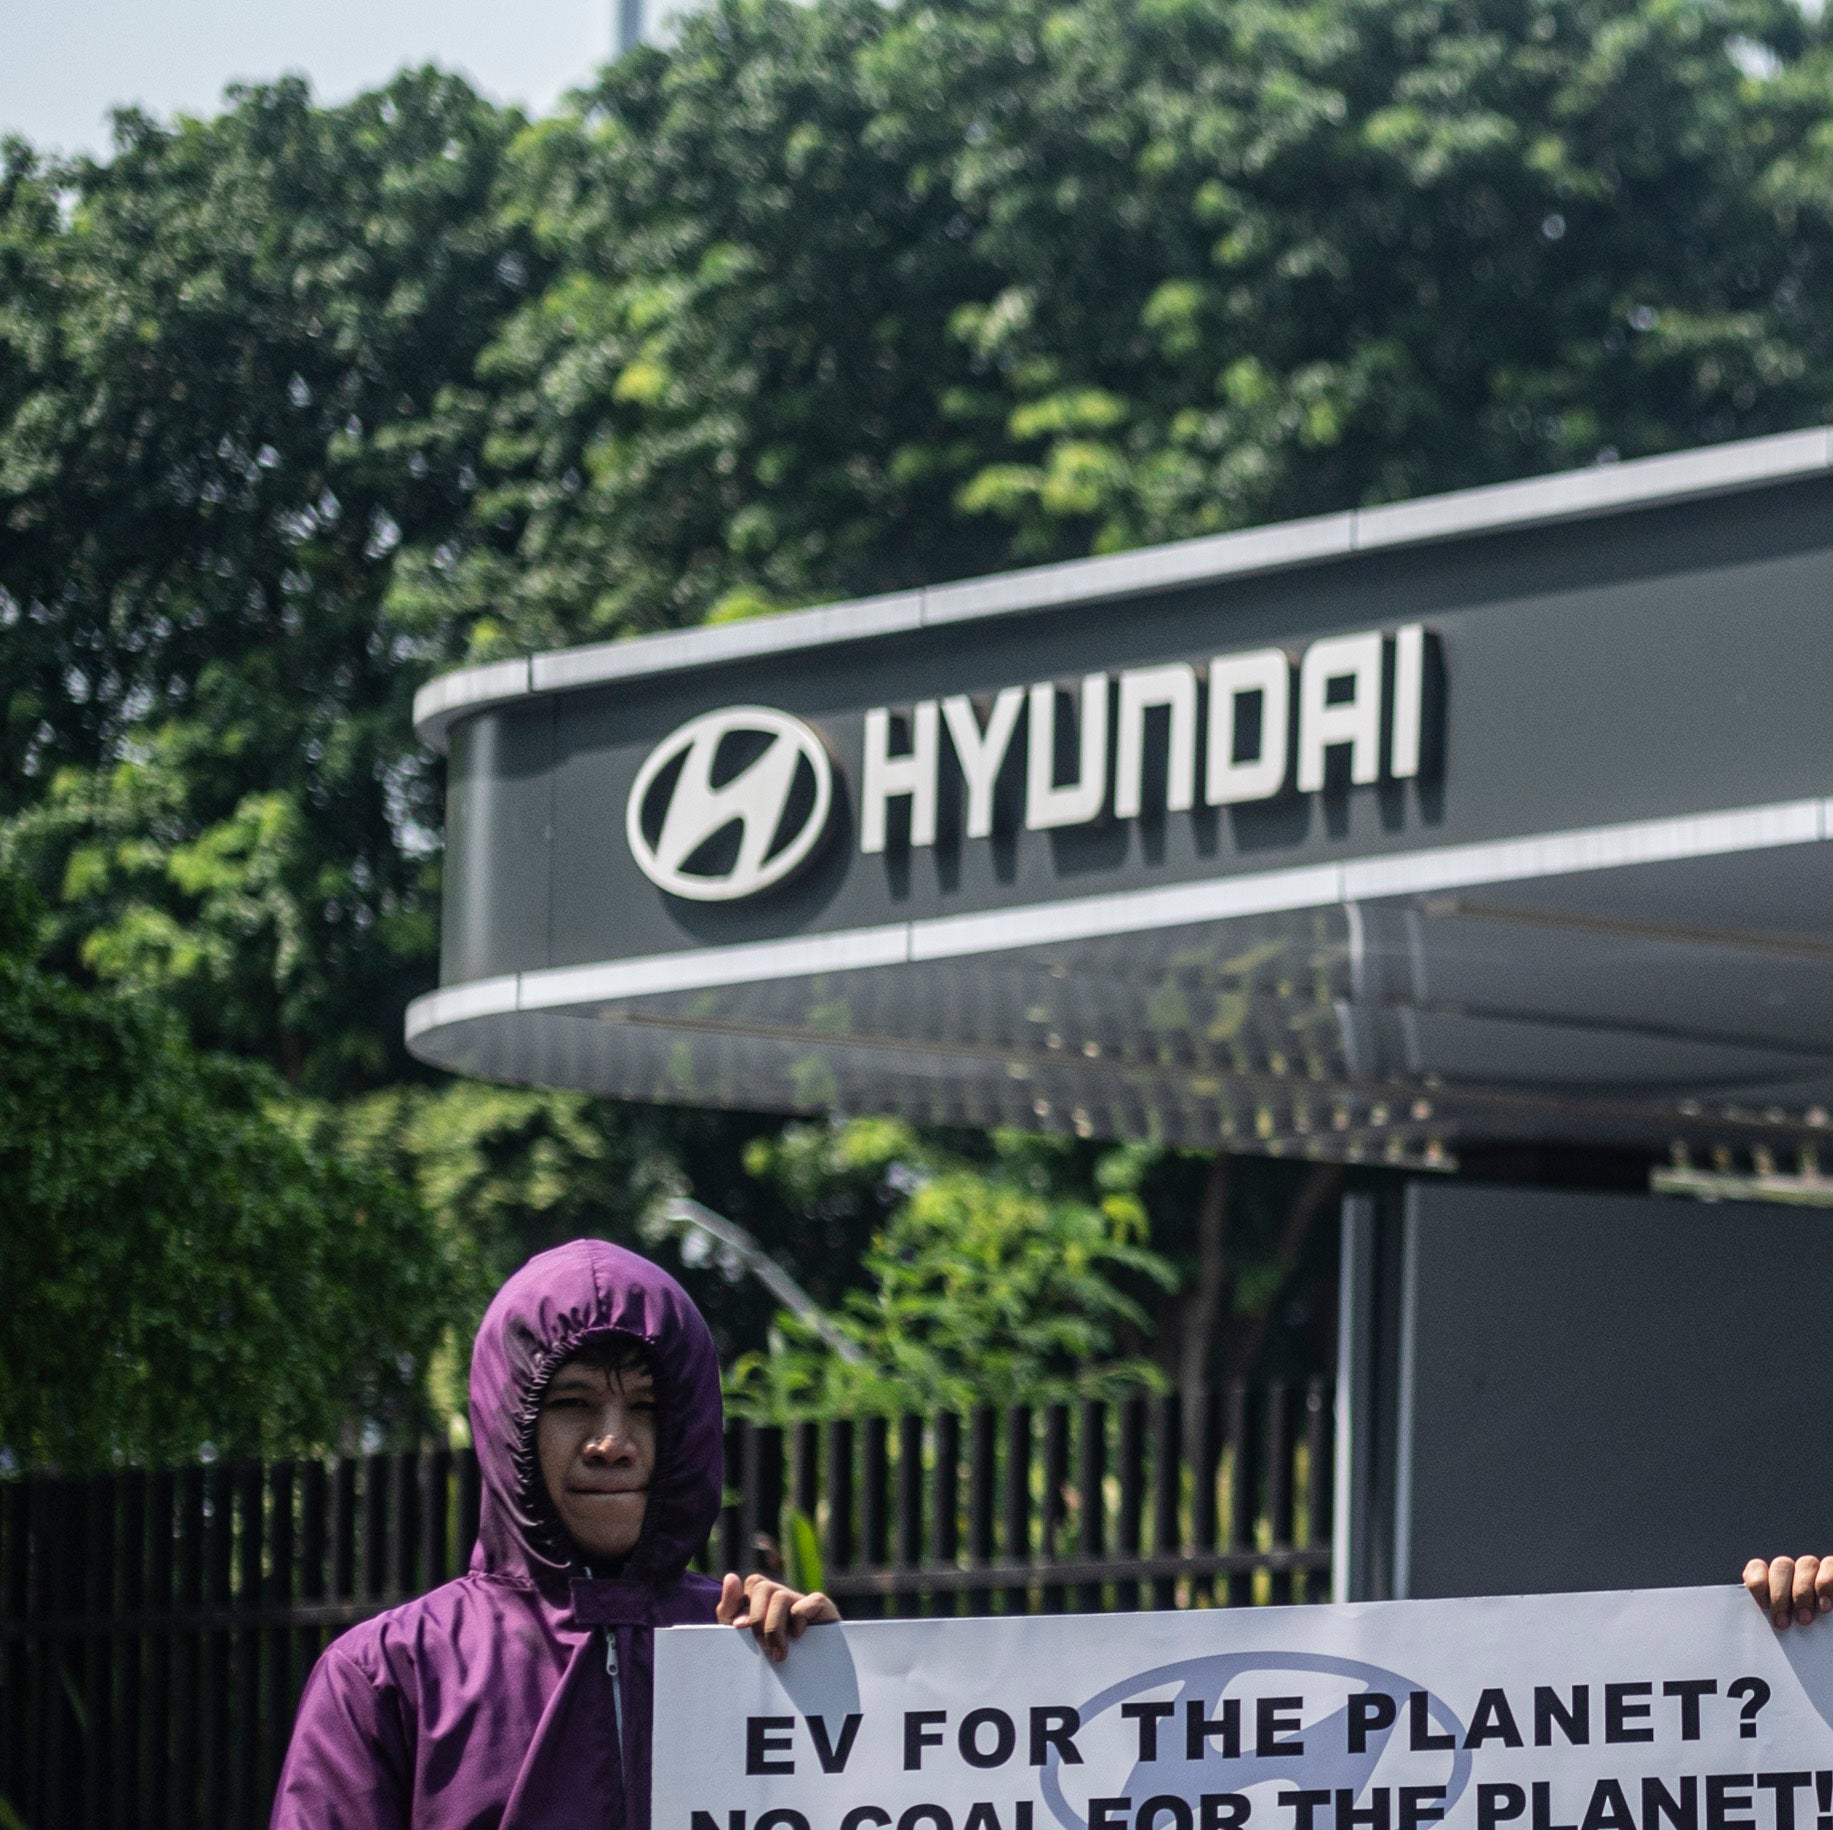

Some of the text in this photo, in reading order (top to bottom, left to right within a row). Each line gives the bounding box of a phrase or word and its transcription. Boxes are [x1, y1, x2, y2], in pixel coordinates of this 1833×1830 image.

[861, 623, 1424, 854] HYUNDAI
[745, 1676, 1772, 1775] EV FOR THE PLANET?
